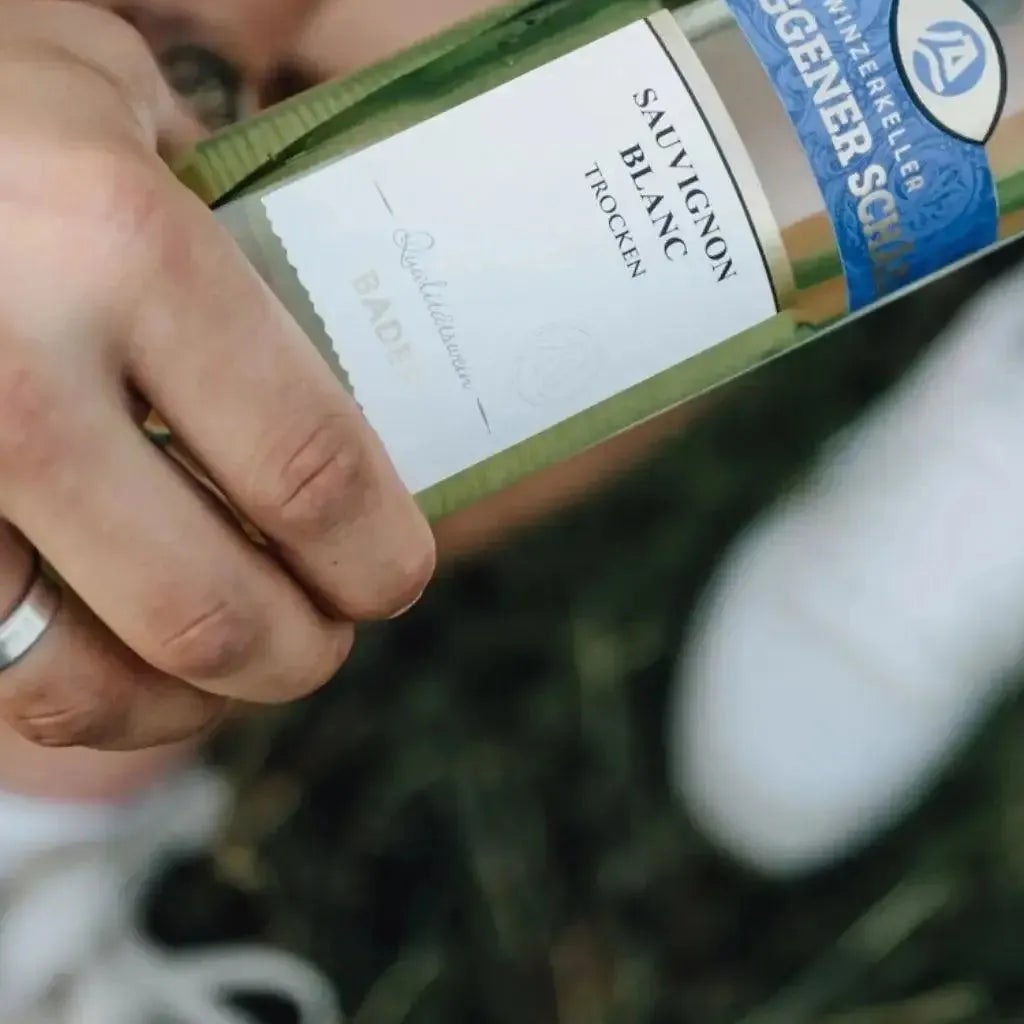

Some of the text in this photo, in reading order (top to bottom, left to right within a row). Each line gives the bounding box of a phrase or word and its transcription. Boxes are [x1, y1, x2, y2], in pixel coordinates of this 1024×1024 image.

[585, 163, 646, 278] TROCKEN
[619, 143, 688, 261] BLANC
[632, 88, 737, 283] SAUVIGNON
[849, 163, 913, 287] SCH
[352, 269, 418, 386] BADE
[394, 228, 471, 389] Qualitätswein
